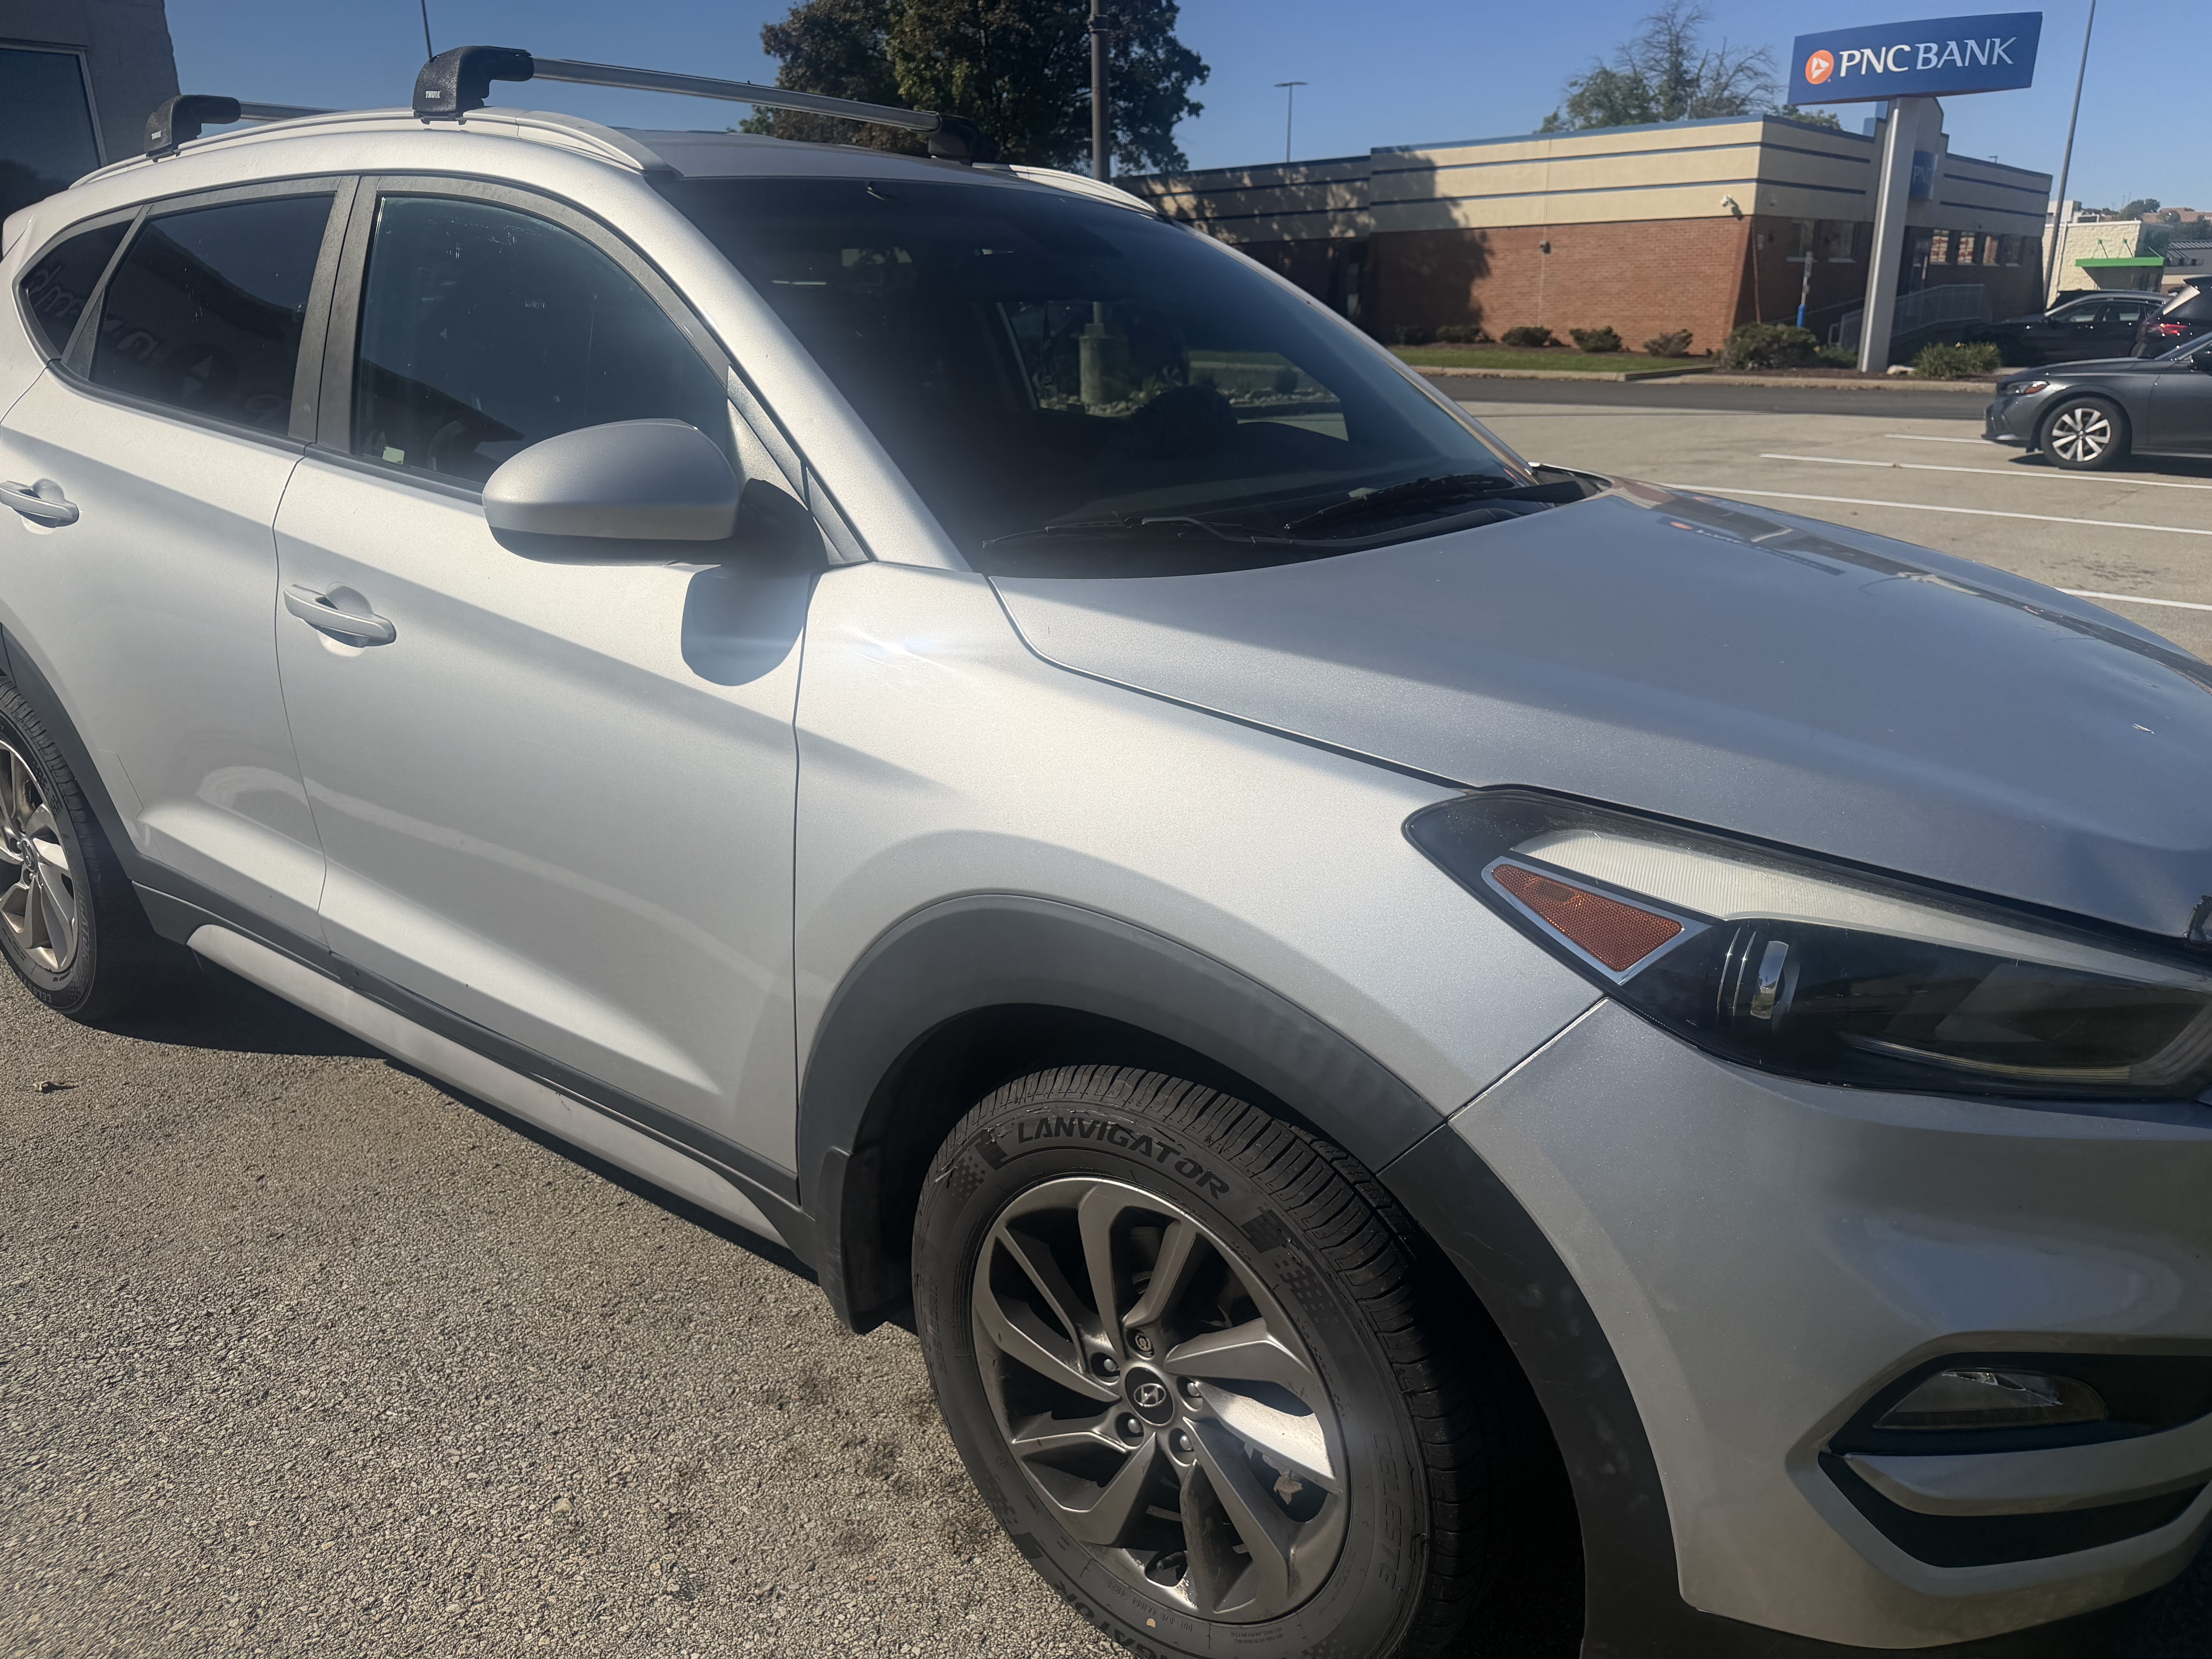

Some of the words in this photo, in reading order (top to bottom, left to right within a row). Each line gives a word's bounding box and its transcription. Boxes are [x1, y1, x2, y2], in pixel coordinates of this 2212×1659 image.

[1839, 44, 1911, 77] PNC
[1915, 37, 2017, 70] BANK
[1018, 1116, 1231, 1200] LANVIGATOR
[1373, 1434, 1402, 1589] CELESTE
